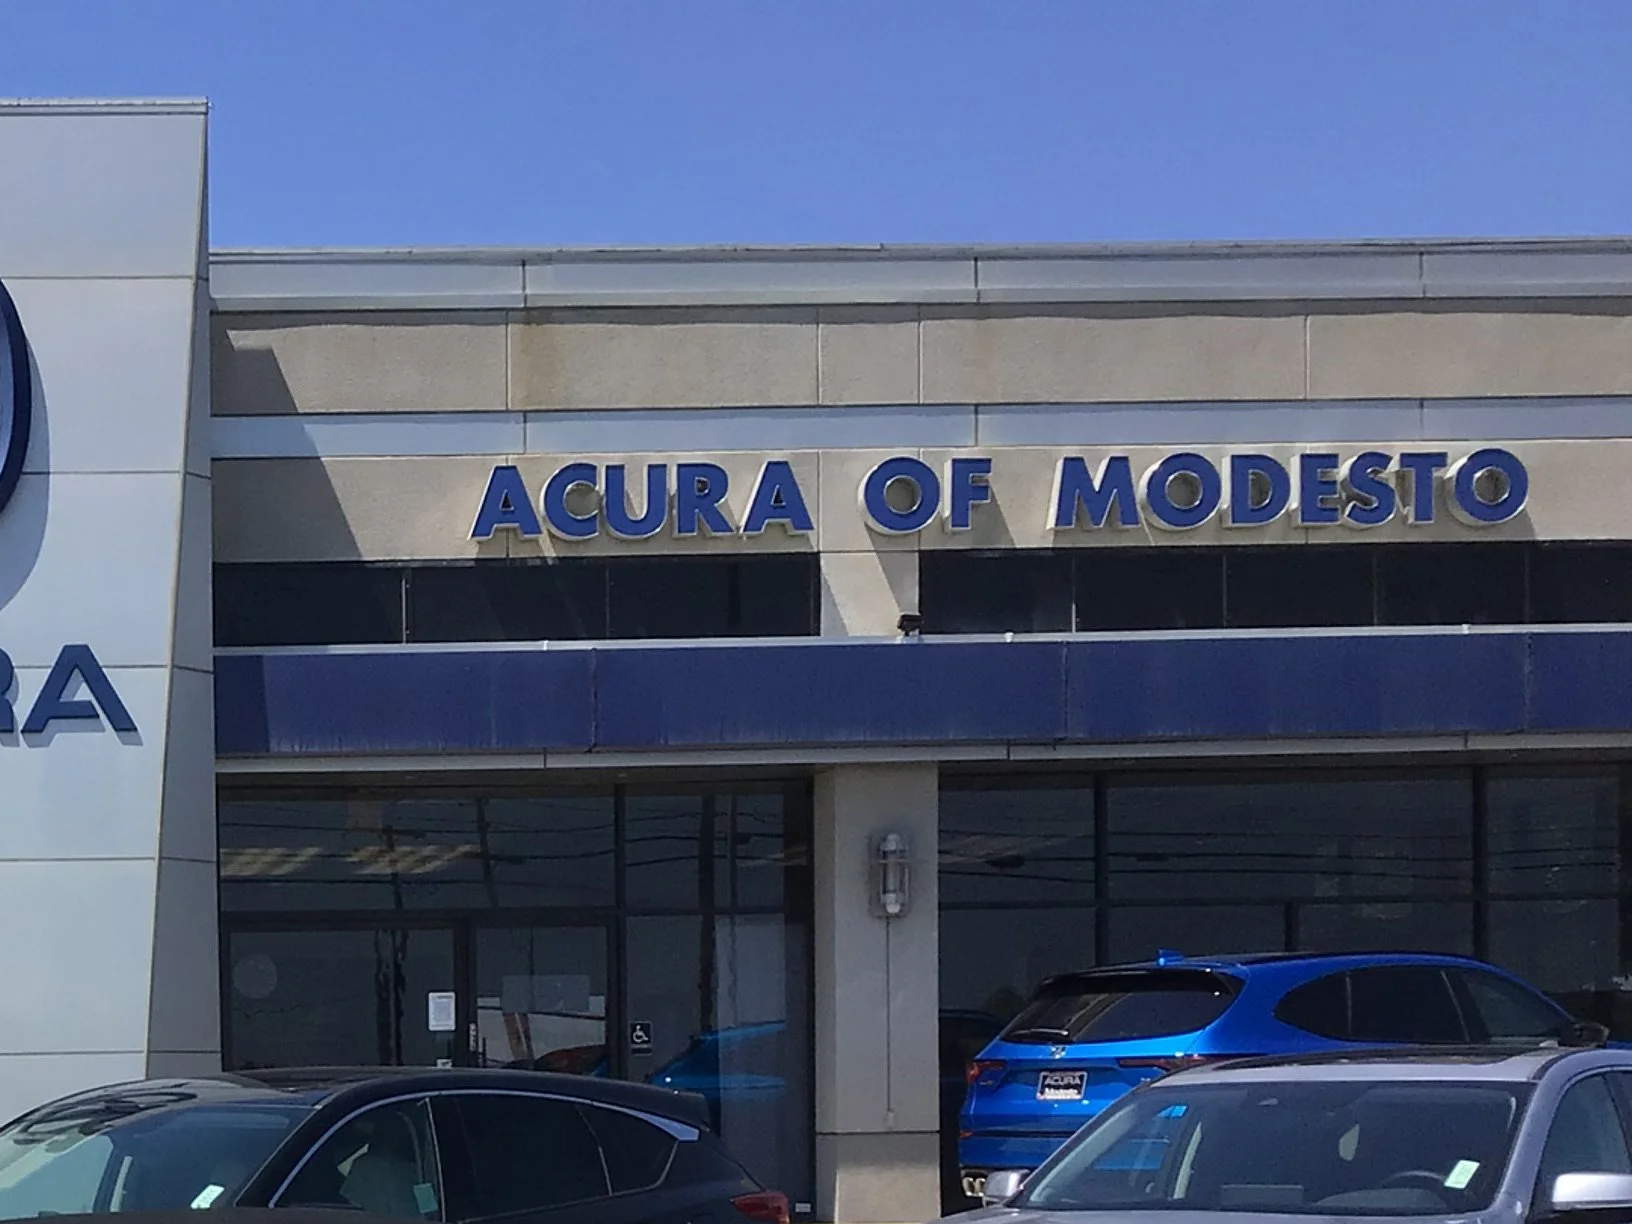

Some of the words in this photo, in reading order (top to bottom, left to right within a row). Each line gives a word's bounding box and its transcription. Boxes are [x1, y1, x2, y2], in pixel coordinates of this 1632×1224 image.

[468, 462, 814, 540] ACURA
[859, 457, 992, 534] OF
[1048, 449, 1529, 531] MODESTO
[1043, 1075, 1081, 1086] ACURA
